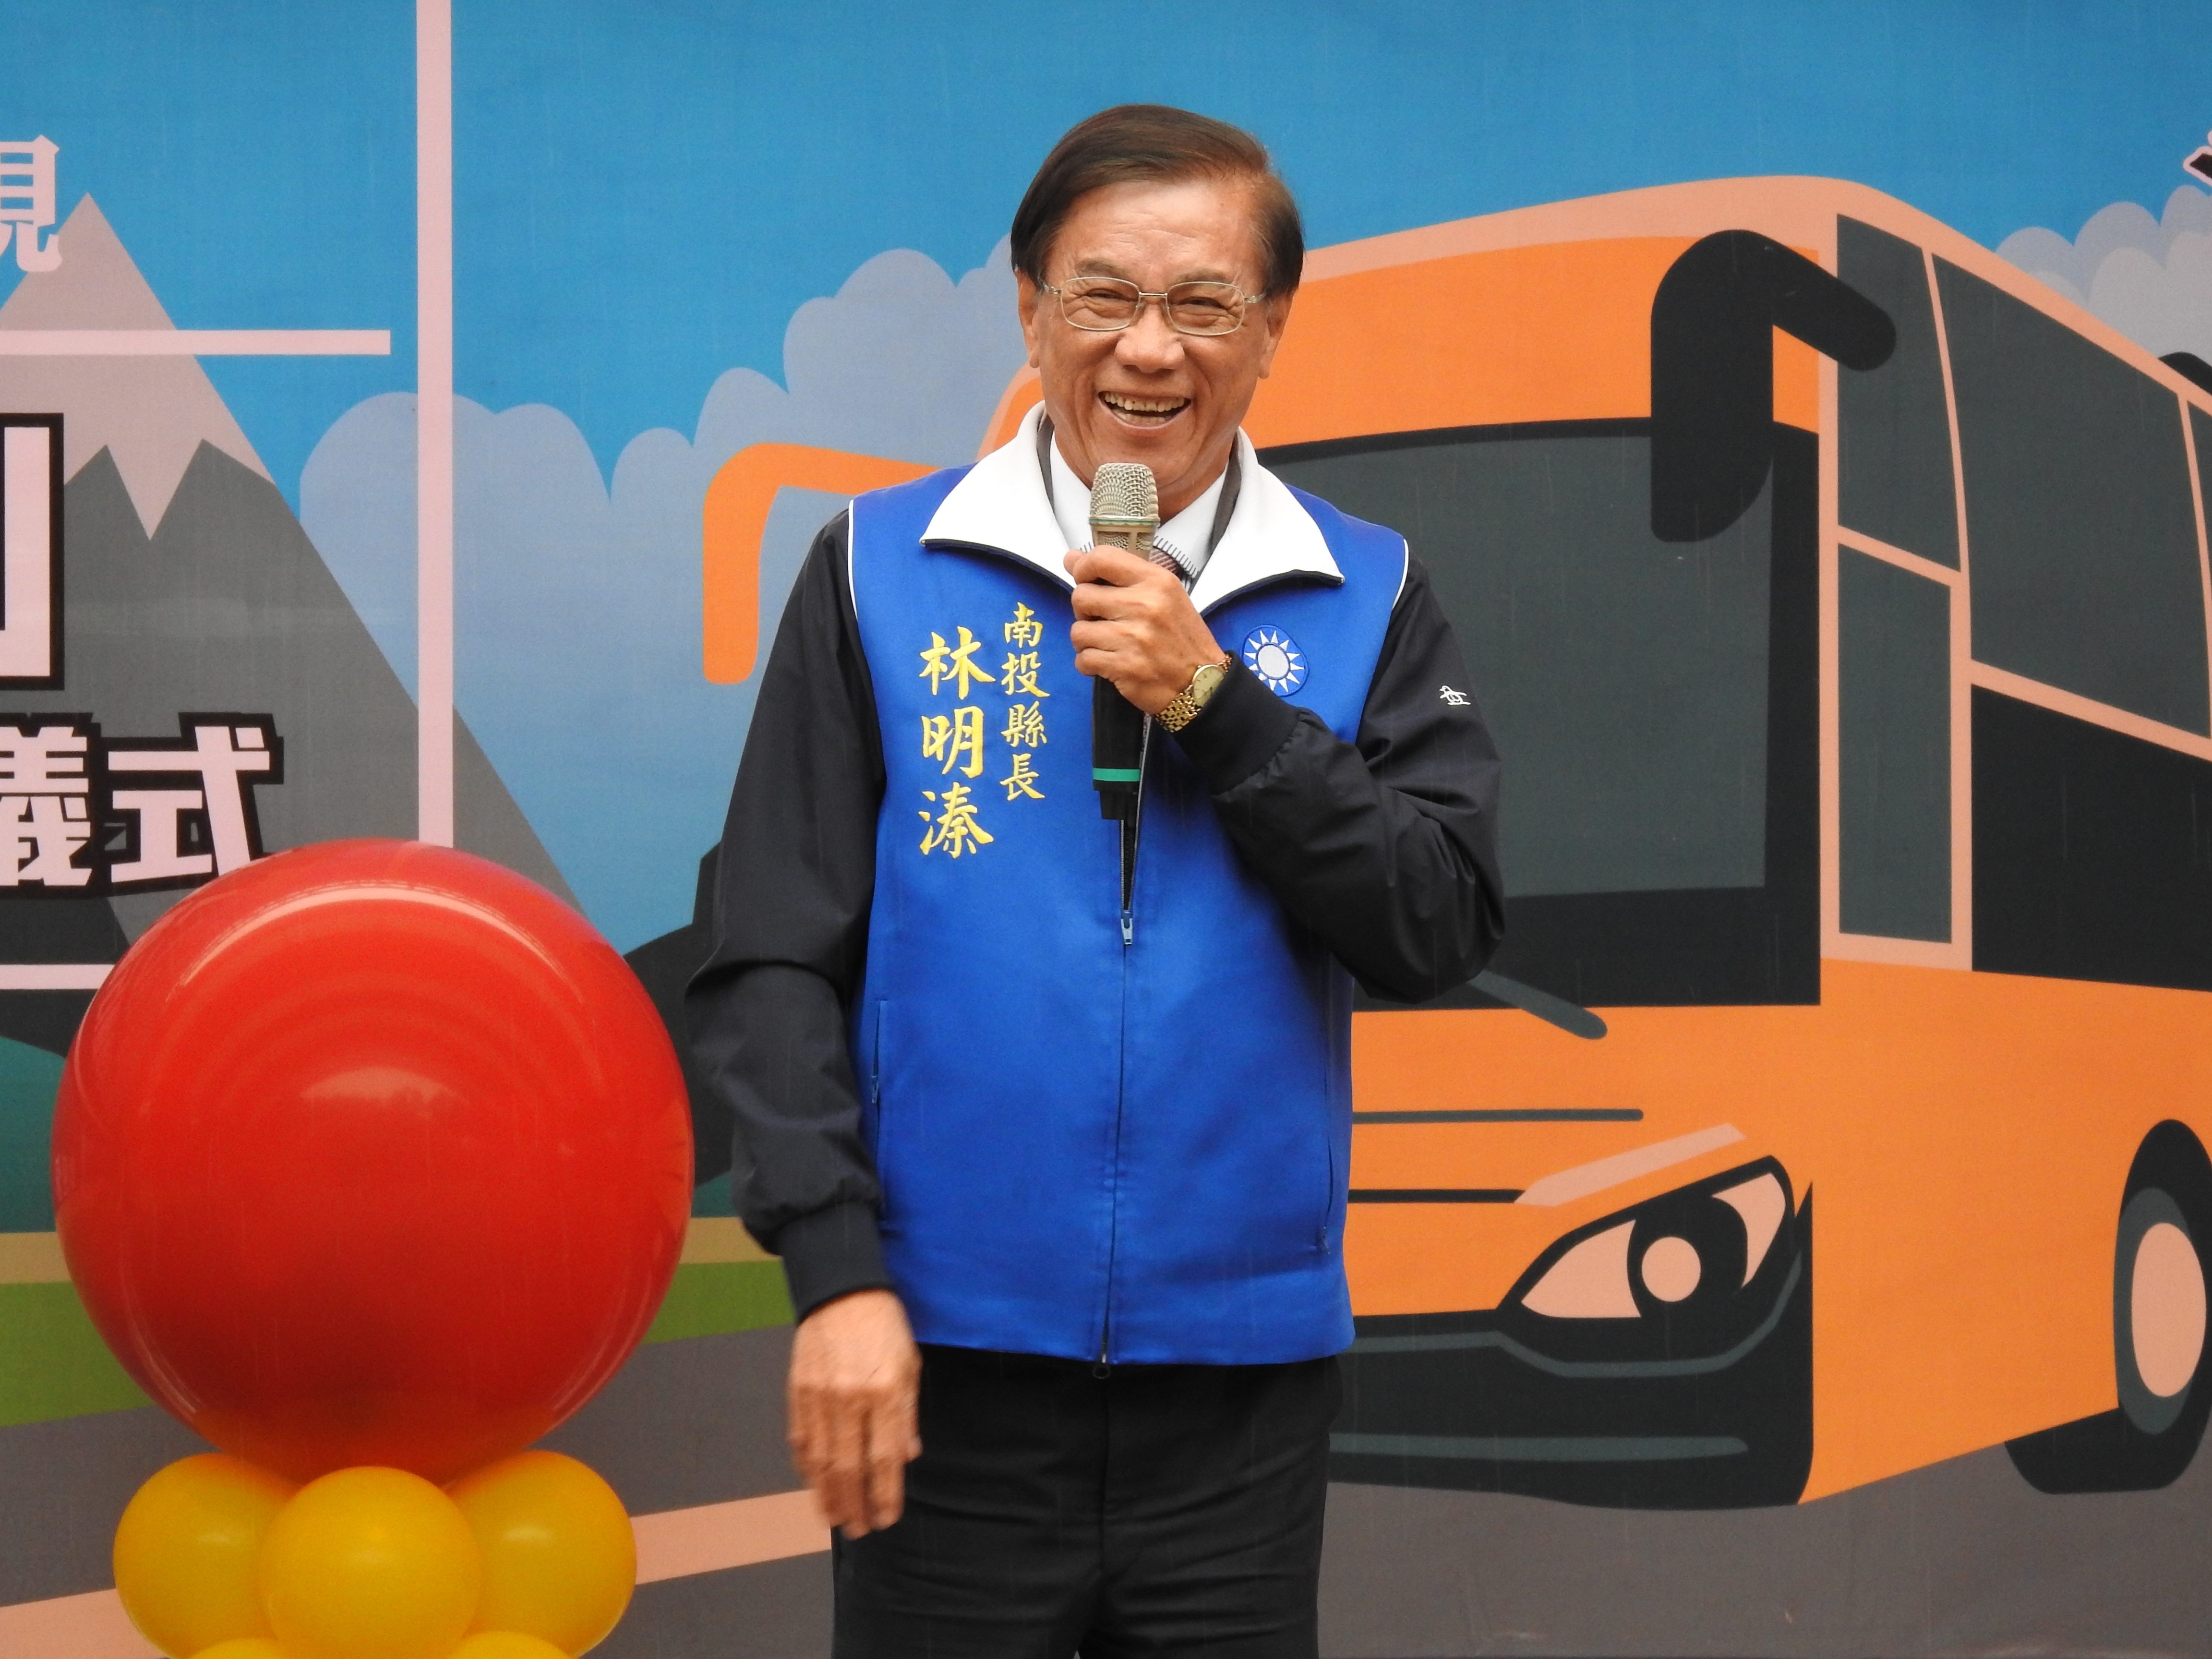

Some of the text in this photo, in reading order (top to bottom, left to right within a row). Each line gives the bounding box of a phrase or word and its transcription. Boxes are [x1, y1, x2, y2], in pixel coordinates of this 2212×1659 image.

[918, 626, 996, 859] 林明溱
[999, 601, 1050, 801] 南投縣長
